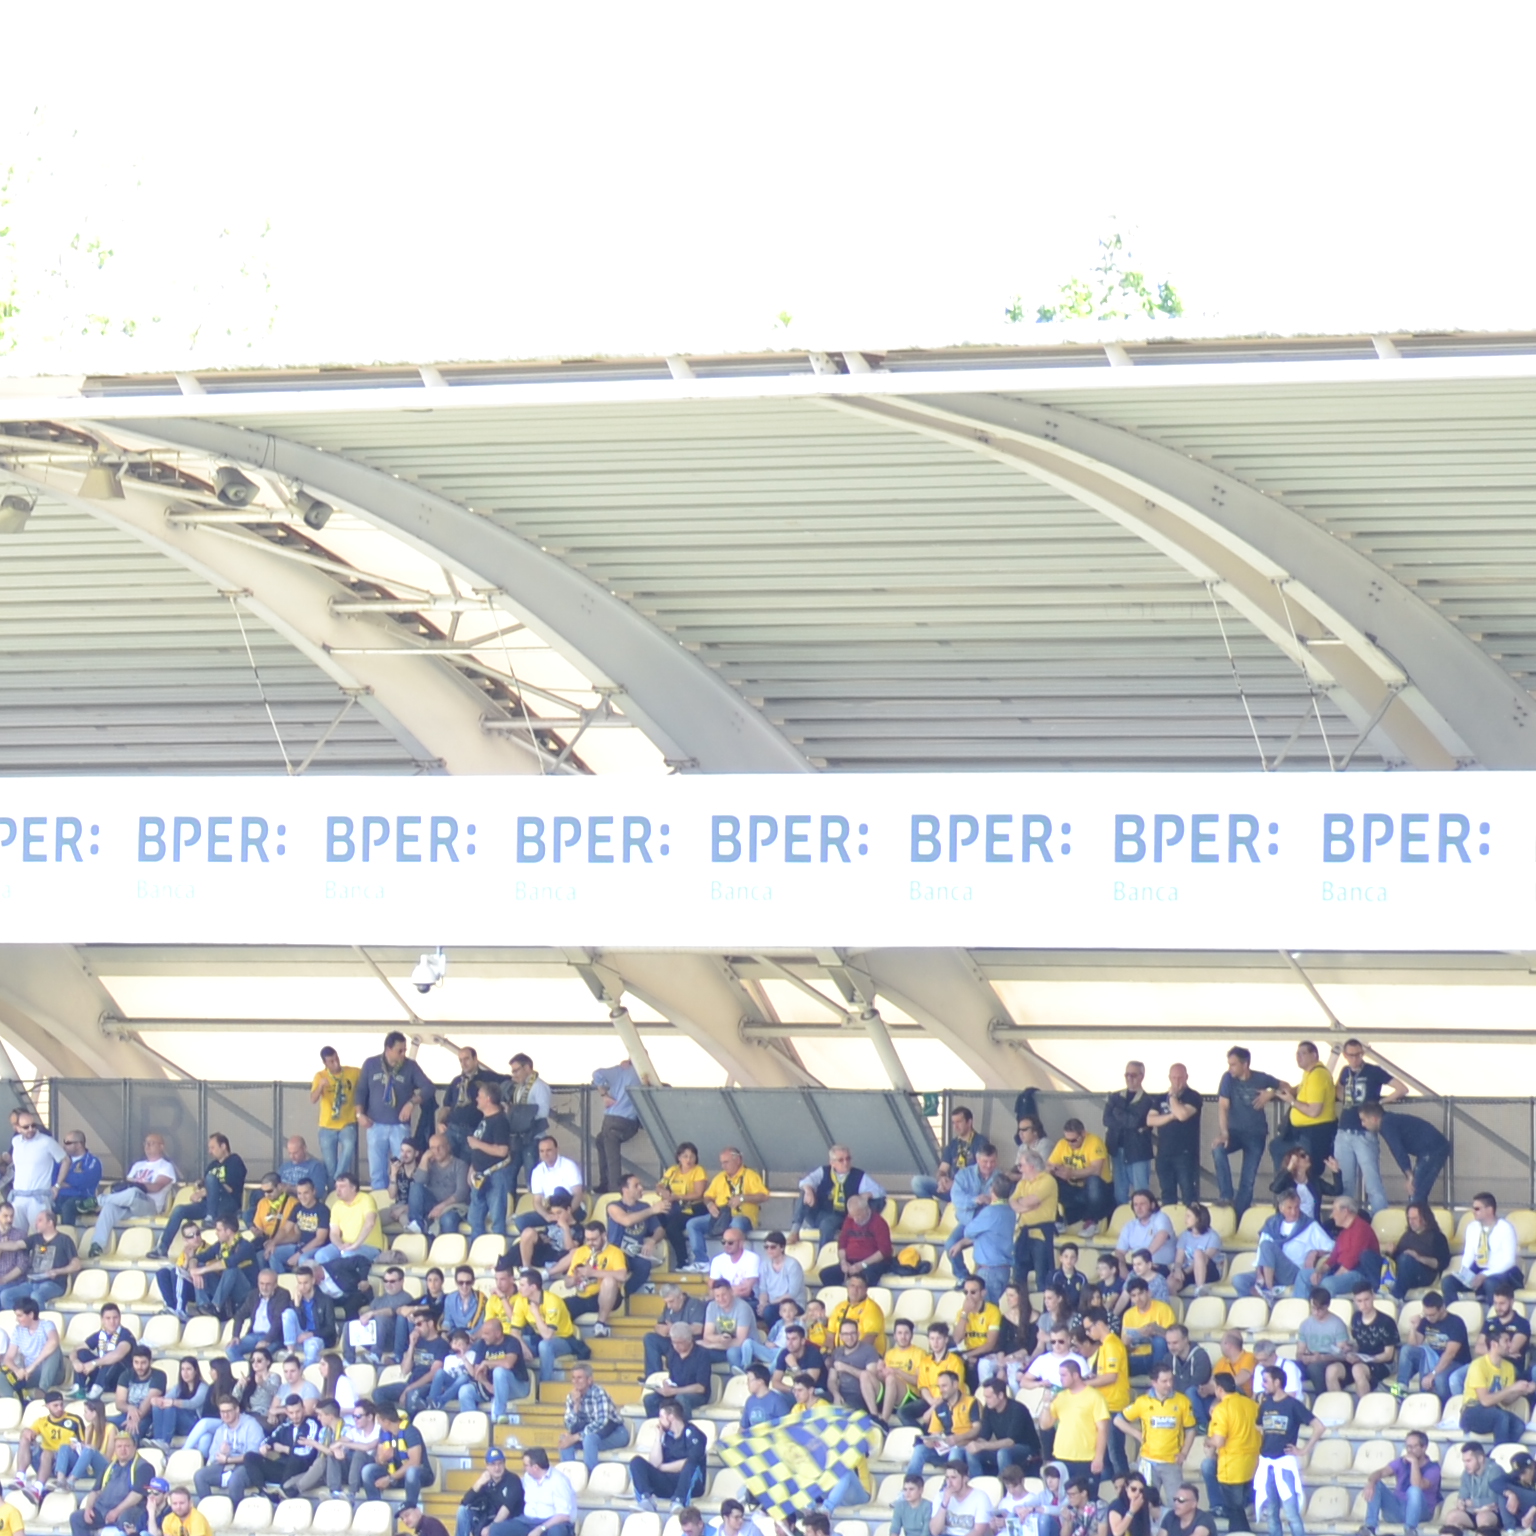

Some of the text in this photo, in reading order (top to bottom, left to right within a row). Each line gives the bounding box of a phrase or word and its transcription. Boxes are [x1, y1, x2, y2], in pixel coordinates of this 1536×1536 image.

[138, 816, 286, 862] BPER:
[326, 816, 476, 862] BPER:
[517, 816, 669, 863] BPER:
[712, 815, 868, 863] BPER:
[911, 814, 1071, 863] BPER:
[1115, 814, 1278, 863] BPER:
[1323, 813, 1490, 863] BPER:
[516, 881, 578, 901] Banca
[711, 881, 774, 901] Banca
[911, 881, 974, 902] Banca
[1115, 881, 1180, 902] Banca
[1323, 881, 1389, 903] Banca
